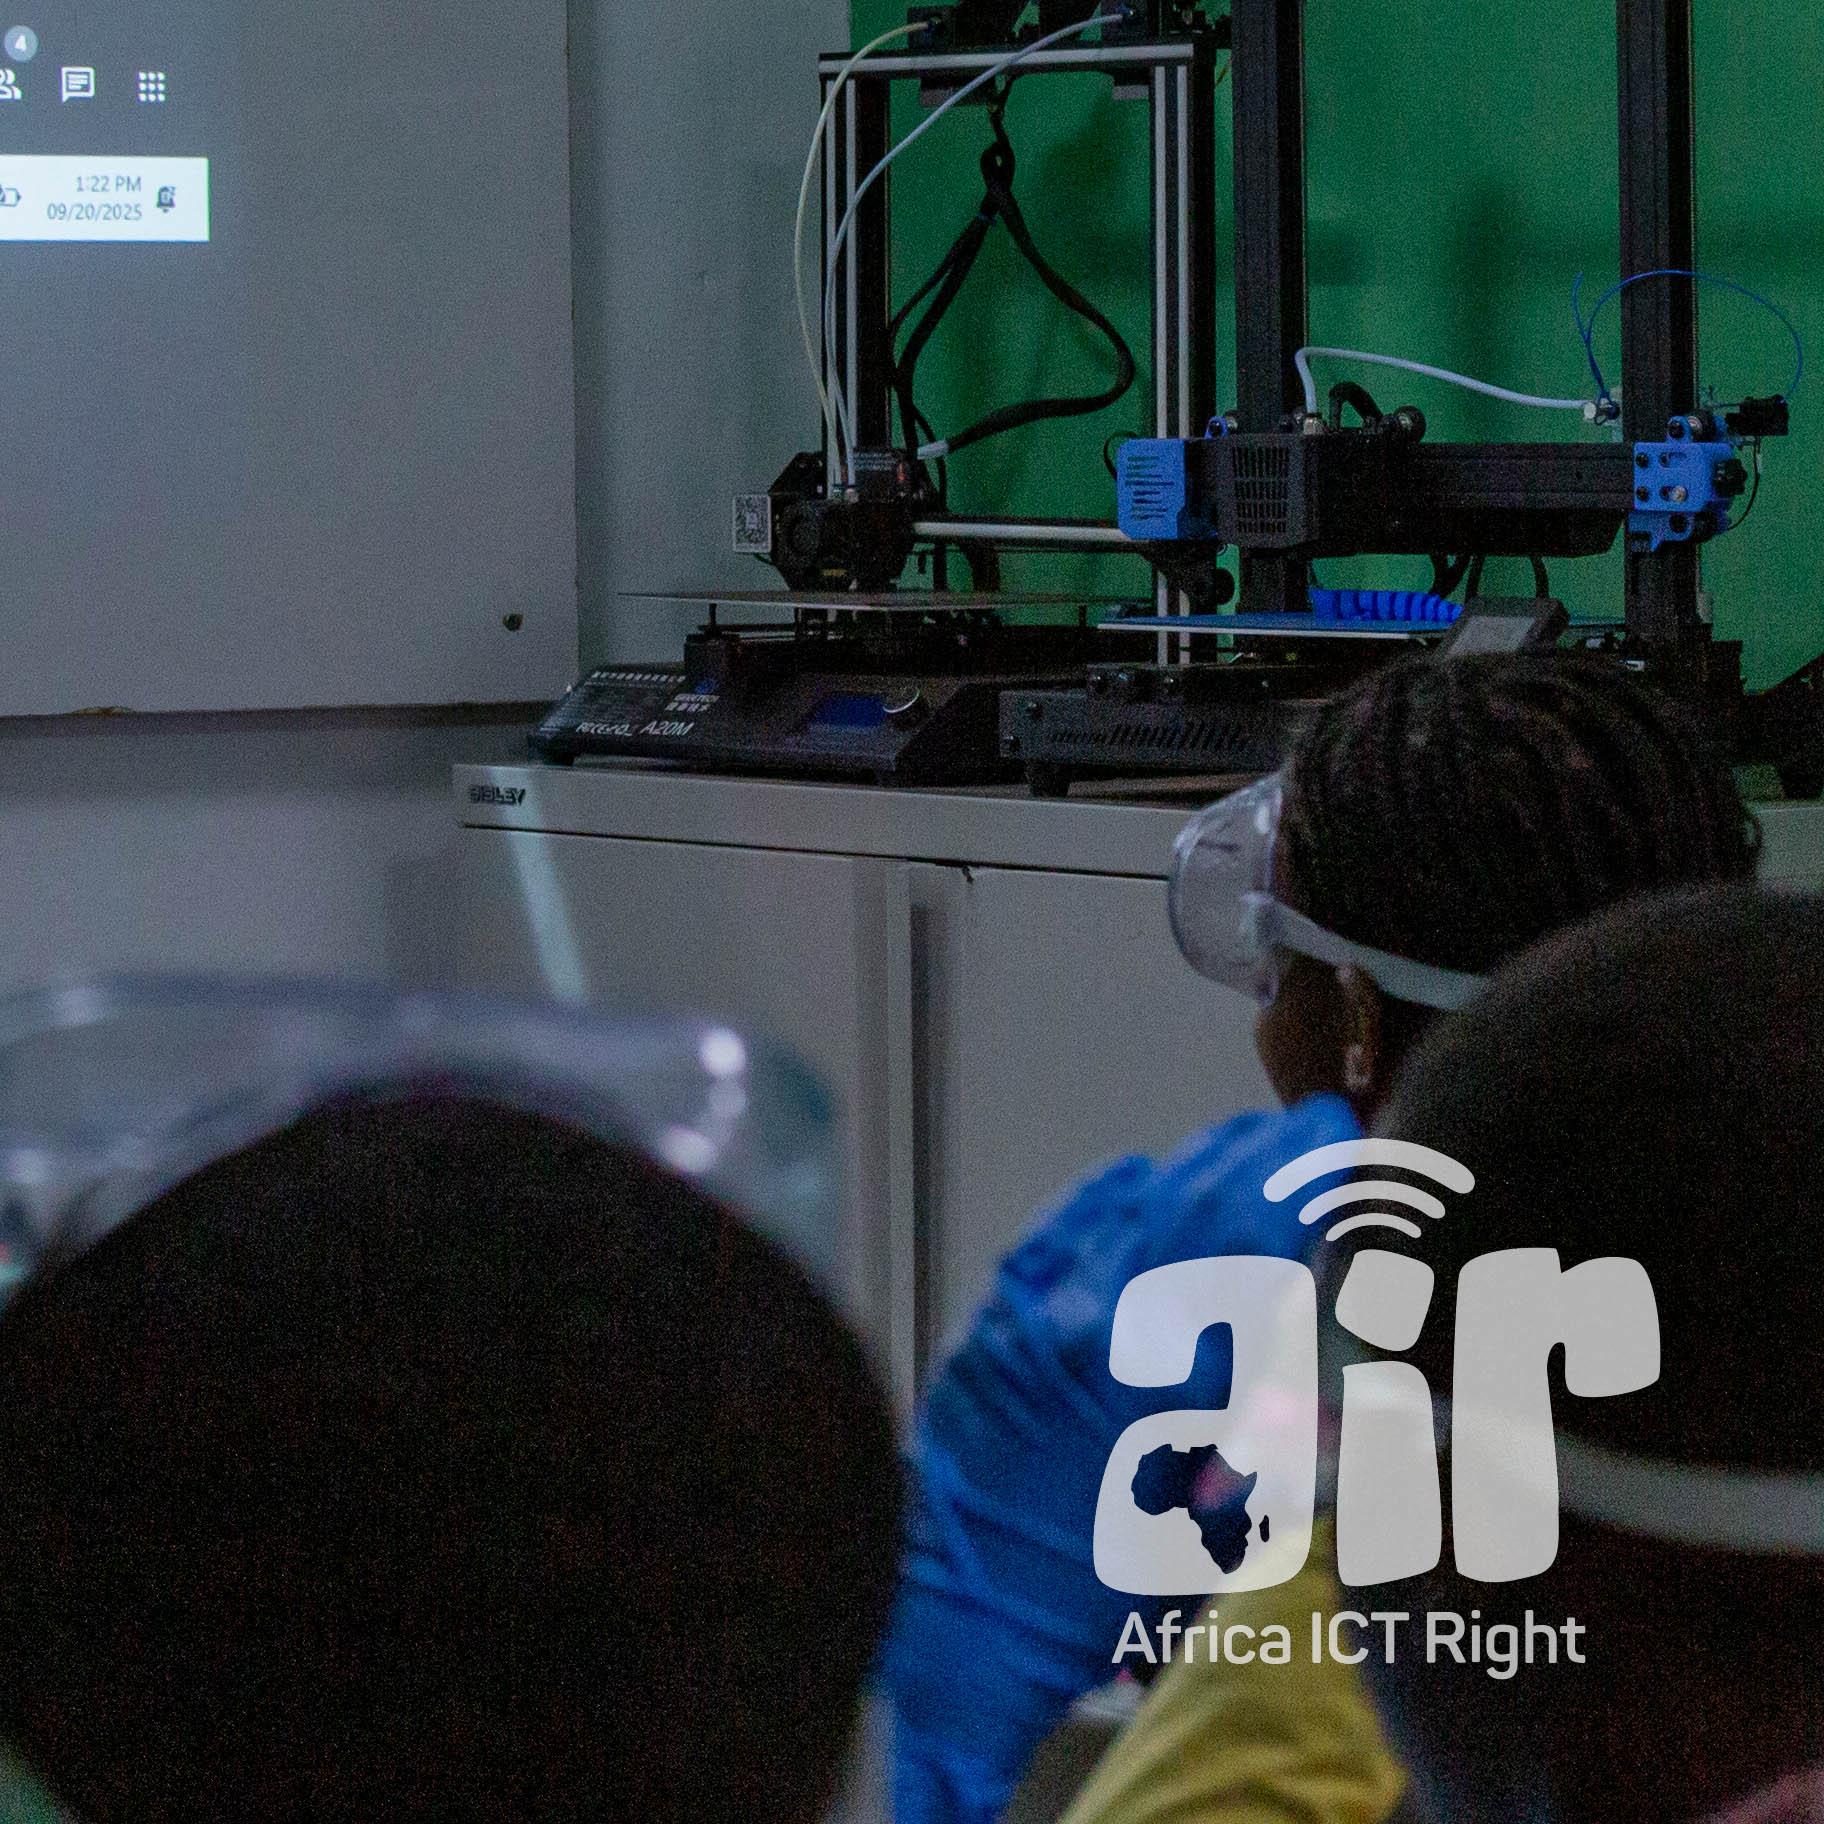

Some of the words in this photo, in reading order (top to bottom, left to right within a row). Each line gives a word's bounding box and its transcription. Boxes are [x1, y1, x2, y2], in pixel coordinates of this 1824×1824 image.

[76, 175, 110, 193] 1:22
[115, 175, 142, 193] PM
[46, 203, 142, 222] 09/20/2025
